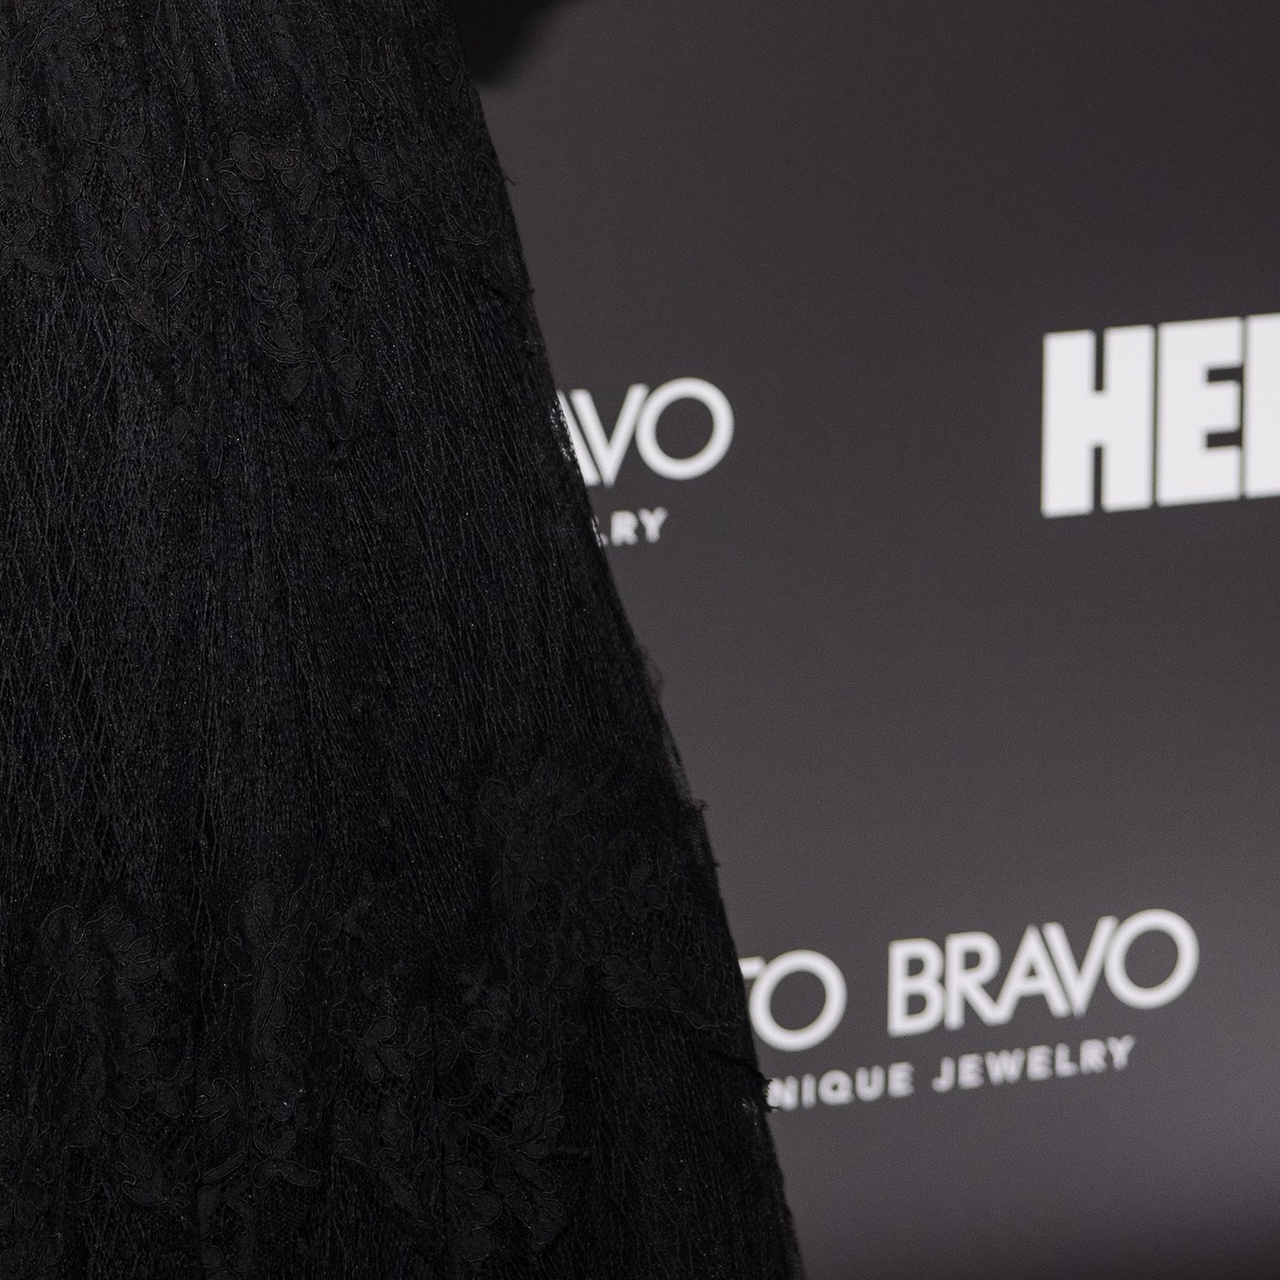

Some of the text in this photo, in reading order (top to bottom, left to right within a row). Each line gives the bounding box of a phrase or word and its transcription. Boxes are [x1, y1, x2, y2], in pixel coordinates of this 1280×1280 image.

[591, 506, 669, 548] RY
[887, 908, 1200, 1037] BRAVO
[931, 1034, 1136, 1094] JEWELRY
